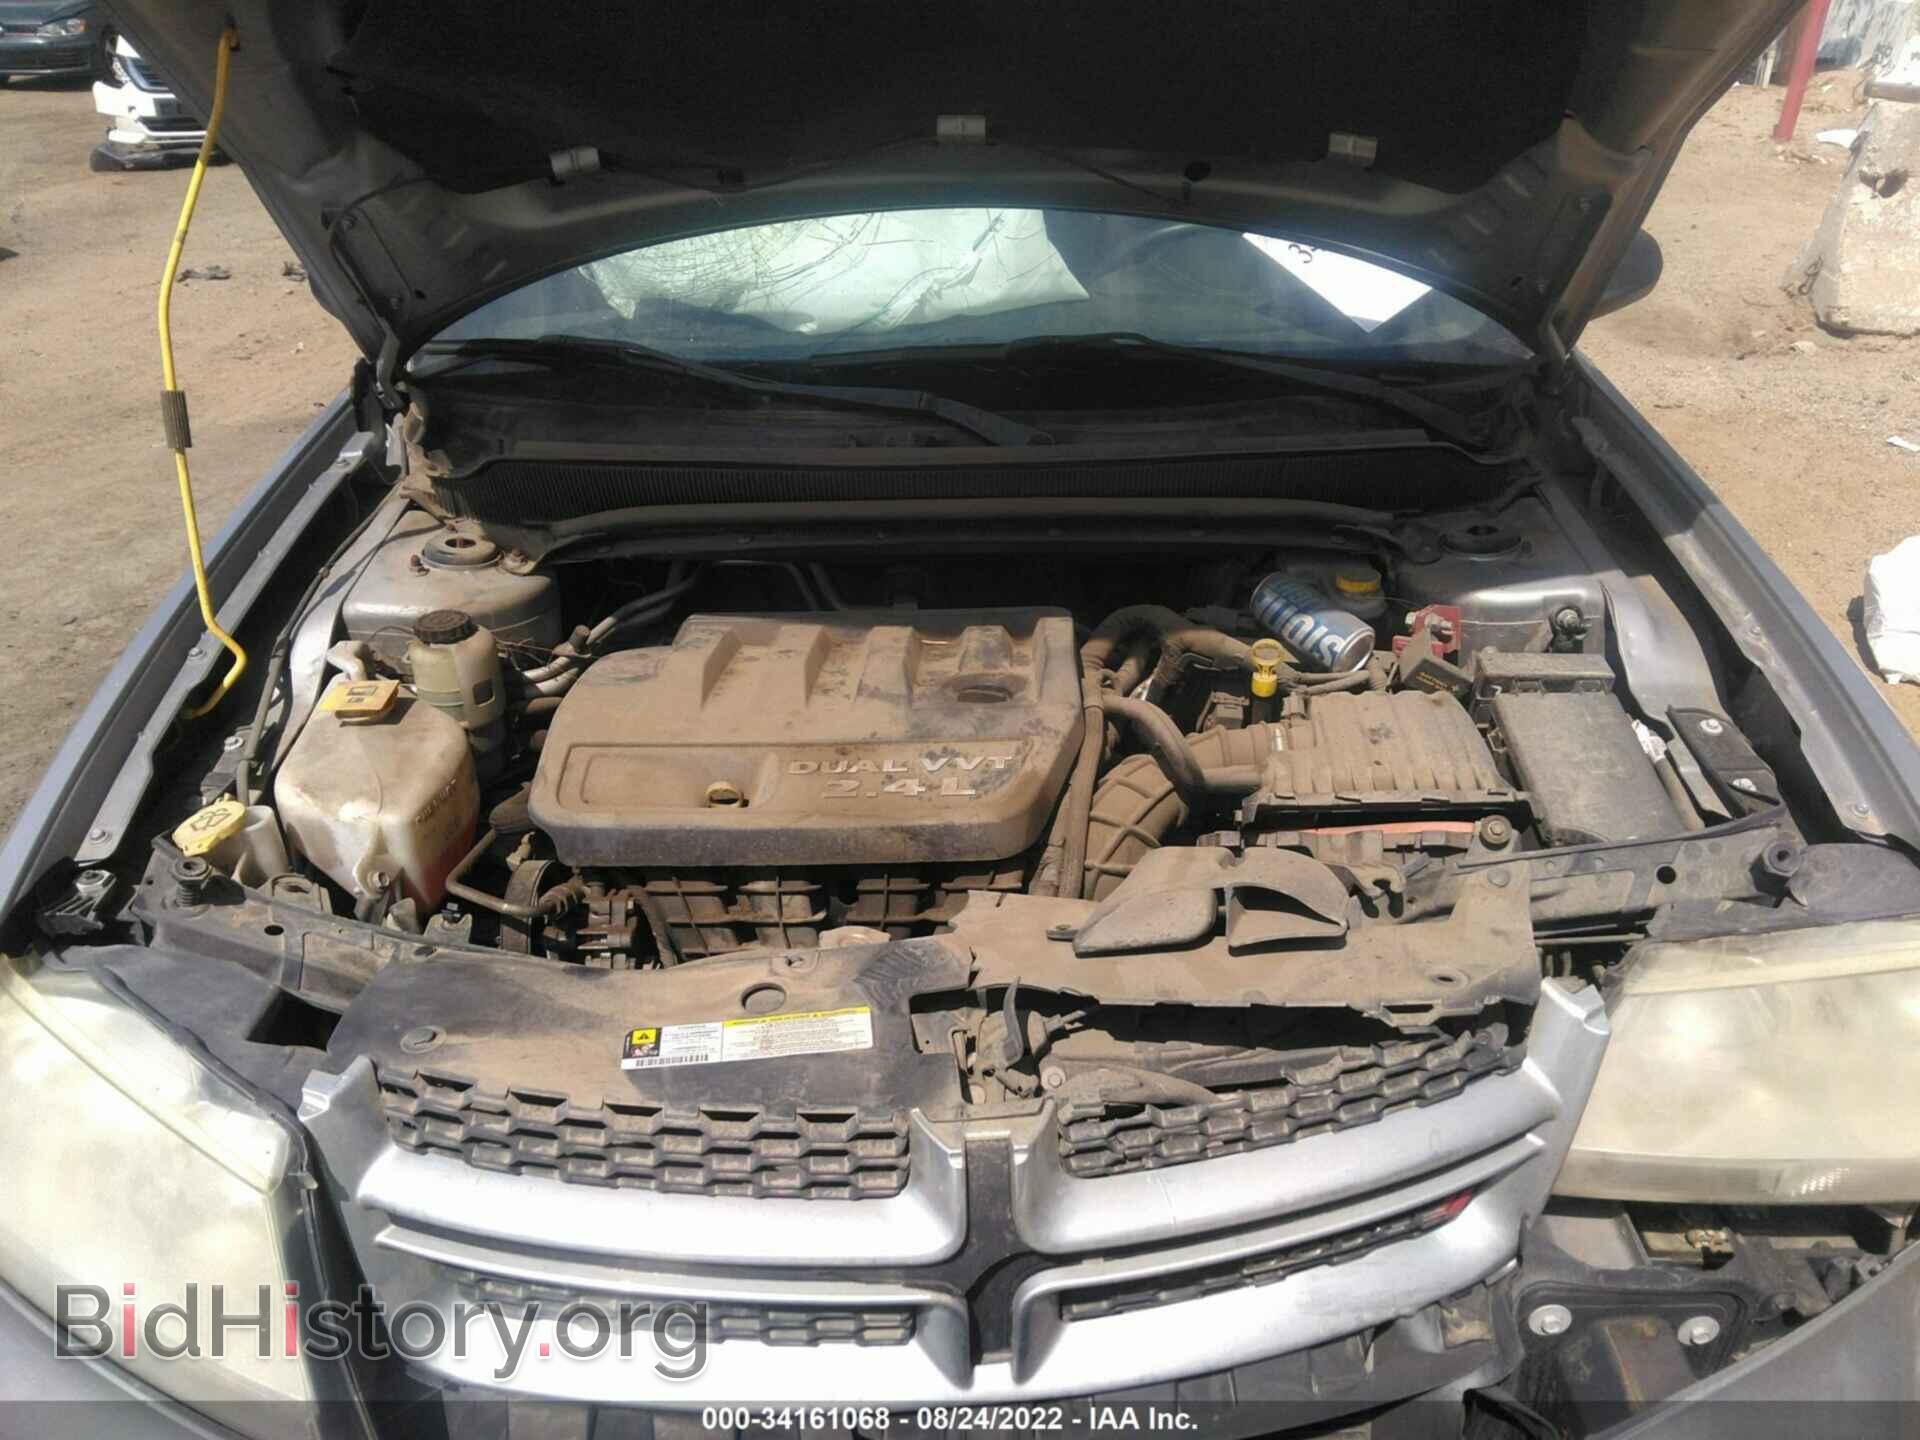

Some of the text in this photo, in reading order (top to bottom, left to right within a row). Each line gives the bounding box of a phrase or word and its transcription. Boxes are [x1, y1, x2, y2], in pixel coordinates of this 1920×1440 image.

[788, 755, 1015, 775] DUAL VVT
[822, 776, 976, 799] 2.4L
